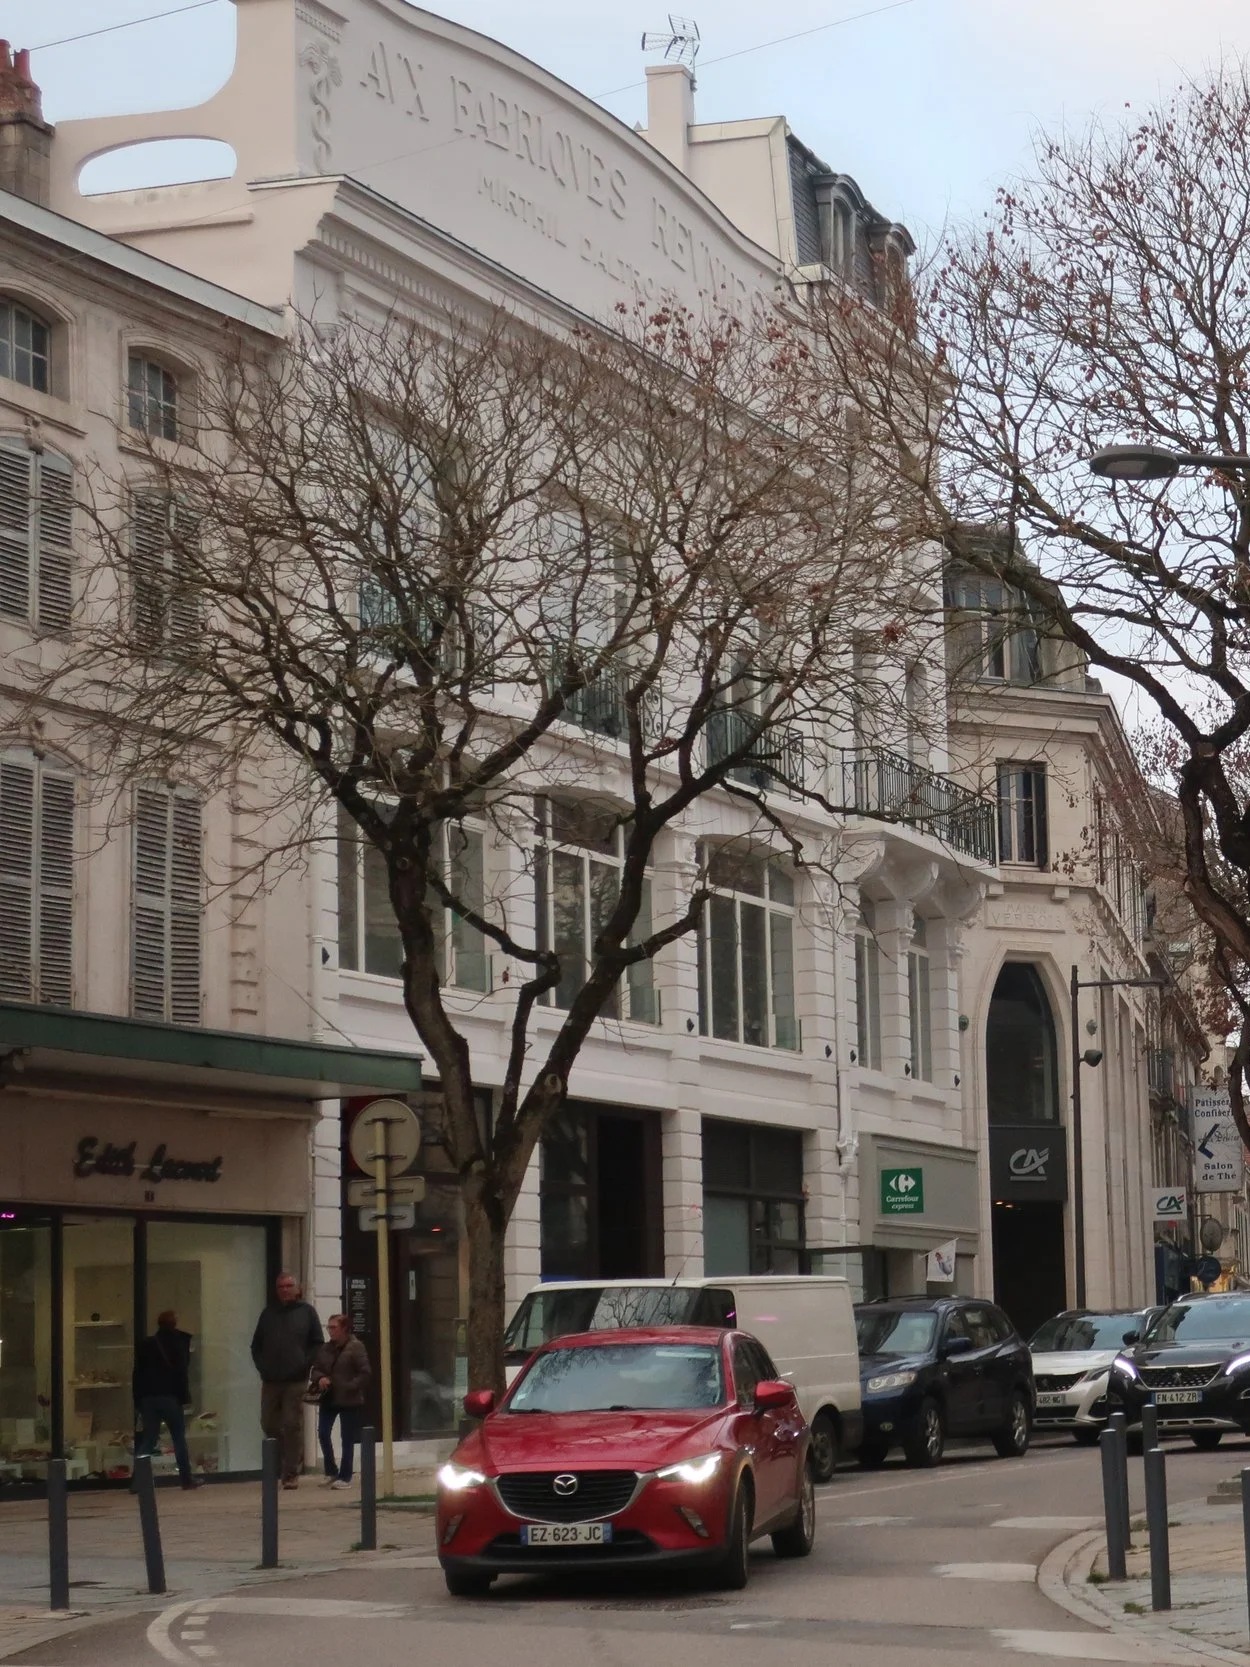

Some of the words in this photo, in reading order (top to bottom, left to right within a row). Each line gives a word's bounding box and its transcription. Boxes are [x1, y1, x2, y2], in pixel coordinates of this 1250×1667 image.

[1204, 1162, 1233, 1170] Salon
[886, 1195, 919, 1203] Carrefour
[891, 1203, 915, 1211] express
[530, 1525, 602, 1542] EZ-623-JC
